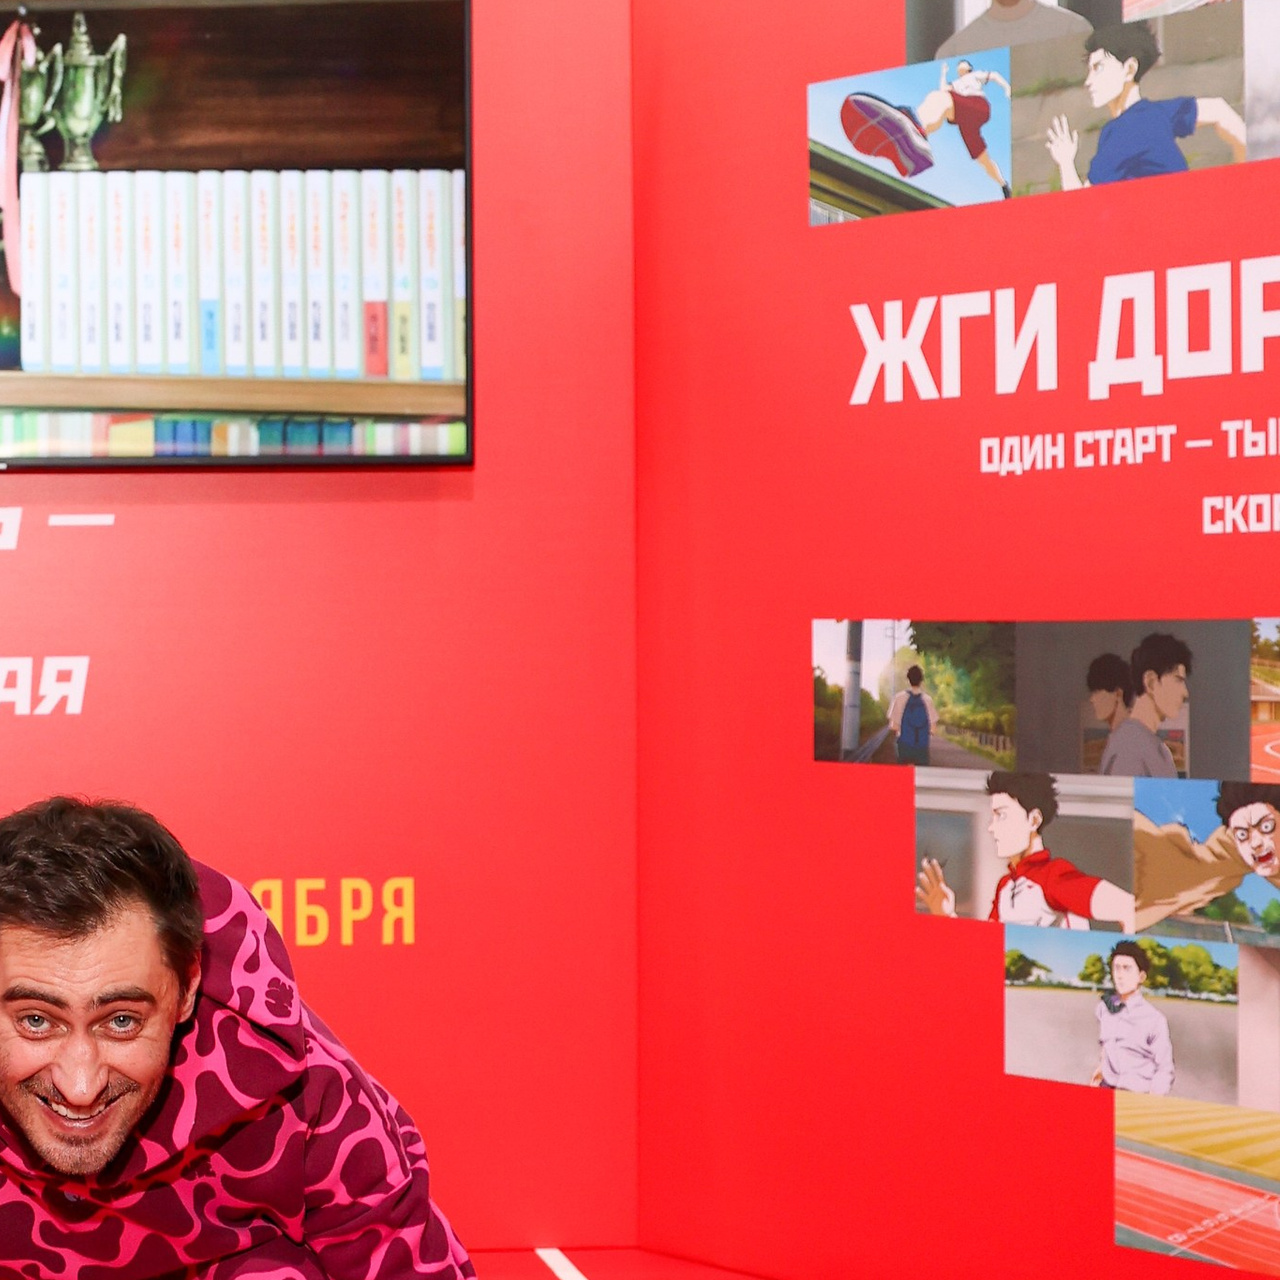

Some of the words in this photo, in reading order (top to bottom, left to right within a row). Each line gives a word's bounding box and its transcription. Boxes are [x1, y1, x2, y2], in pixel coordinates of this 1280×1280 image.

[849, 282, 1058, 405] ЖГИ
[980, 433, 1065, 477] ОДИН
[1074, 424, 1177, 468] СТАРТ
[1221, 417, 1280, 458] ТЫ
